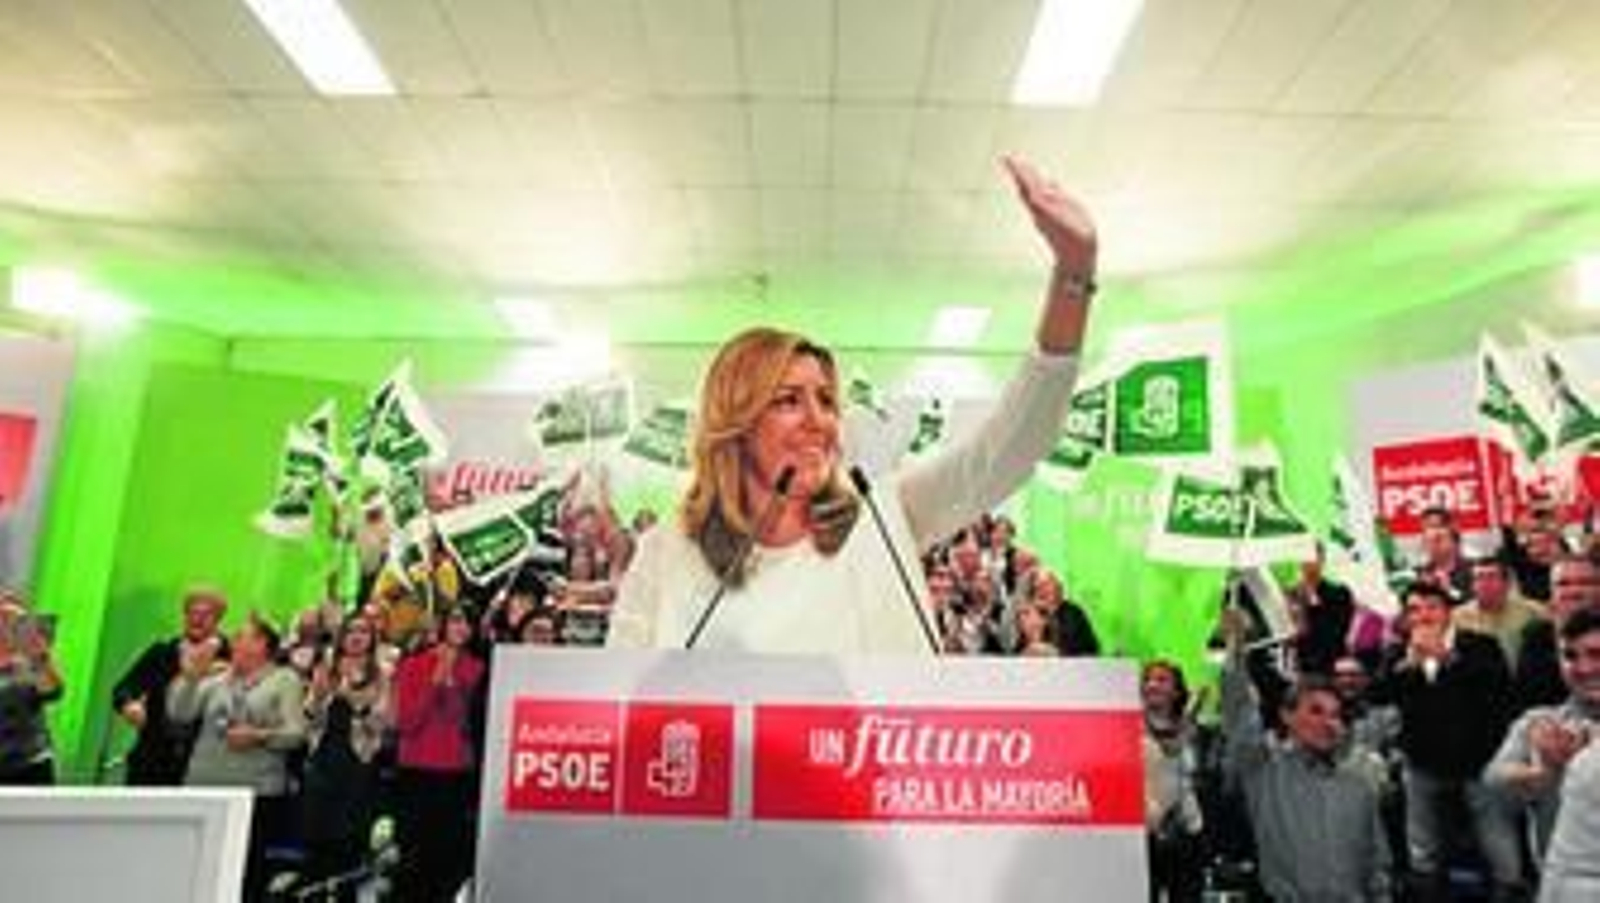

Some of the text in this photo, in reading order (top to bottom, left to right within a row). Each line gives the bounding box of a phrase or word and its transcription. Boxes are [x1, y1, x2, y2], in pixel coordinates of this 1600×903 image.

[1381, 480, 1481, 517] PSOE
[808, 729, 845, 765] UN
[513, 752, 611, 792] PSOE
[873, 775, 1091, 815] PARA LA MAYORÍA
